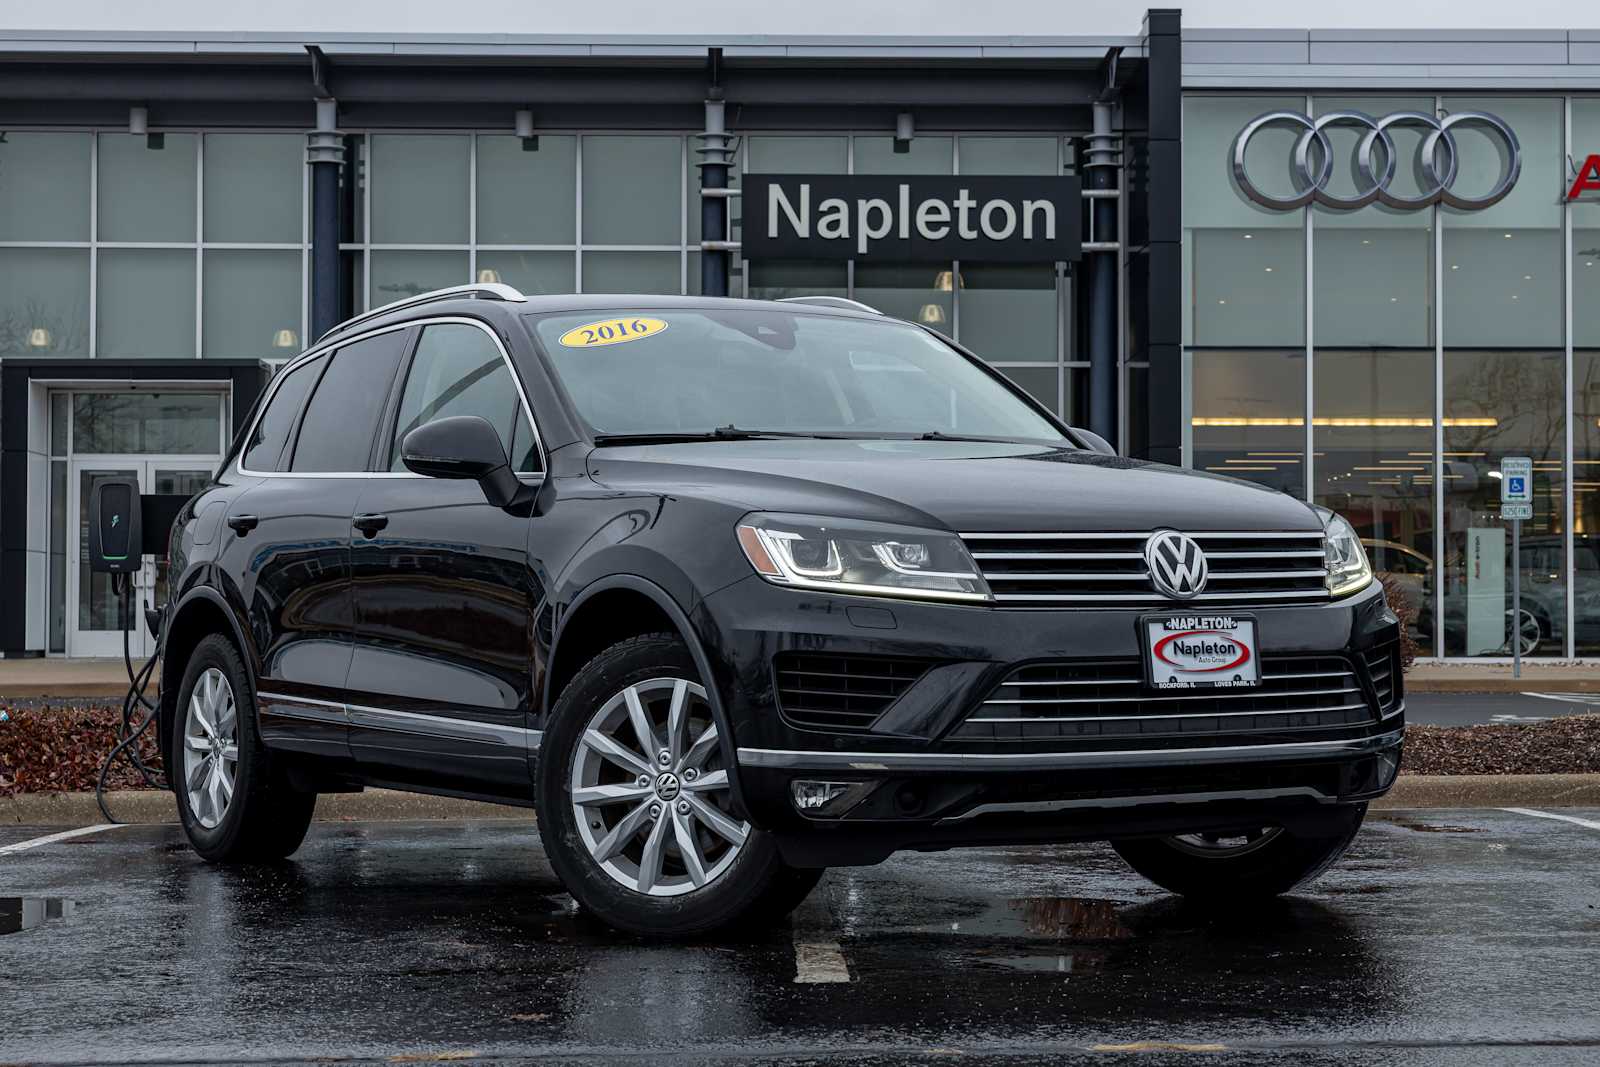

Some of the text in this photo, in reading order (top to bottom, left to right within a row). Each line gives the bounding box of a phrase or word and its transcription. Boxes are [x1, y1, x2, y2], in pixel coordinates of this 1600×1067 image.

[768, 183, 1056, 254] Napleton
[580, 319, 648, 344] 2016
[1171, 617, 1232, 630] NAPLETON
[1174, 641, 1235, 658] Napleton
[1212, 656, 1226, 664] Group
